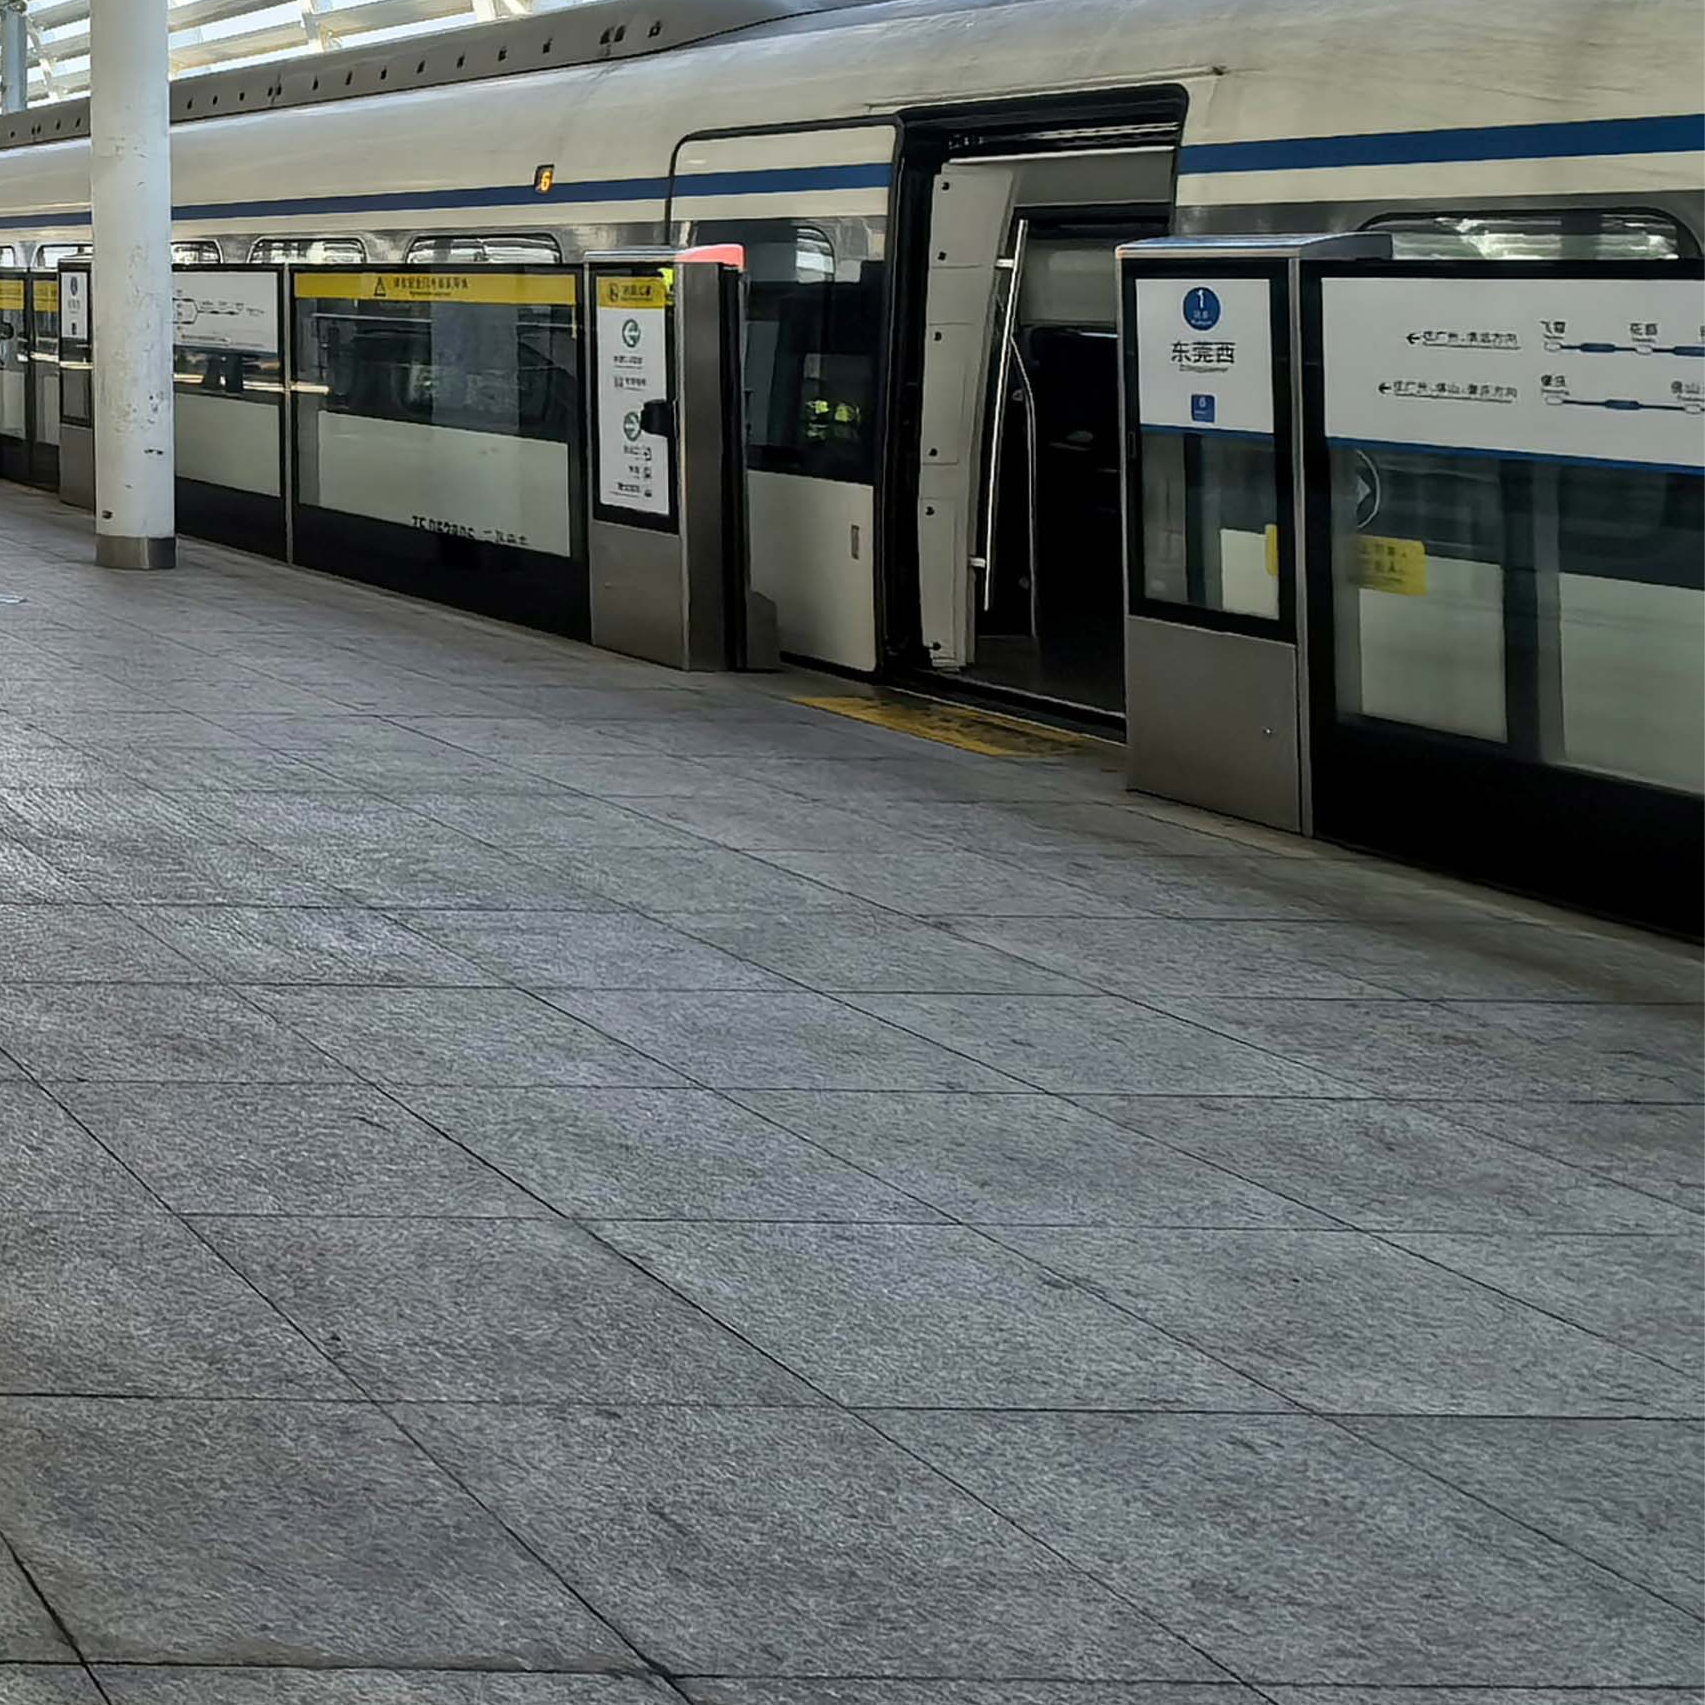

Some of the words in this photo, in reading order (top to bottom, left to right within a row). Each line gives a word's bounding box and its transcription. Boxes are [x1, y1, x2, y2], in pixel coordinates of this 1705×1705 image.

[1198, 289, 1205, 309] 1
[1171, 341, 1236, 364] 东莞西
